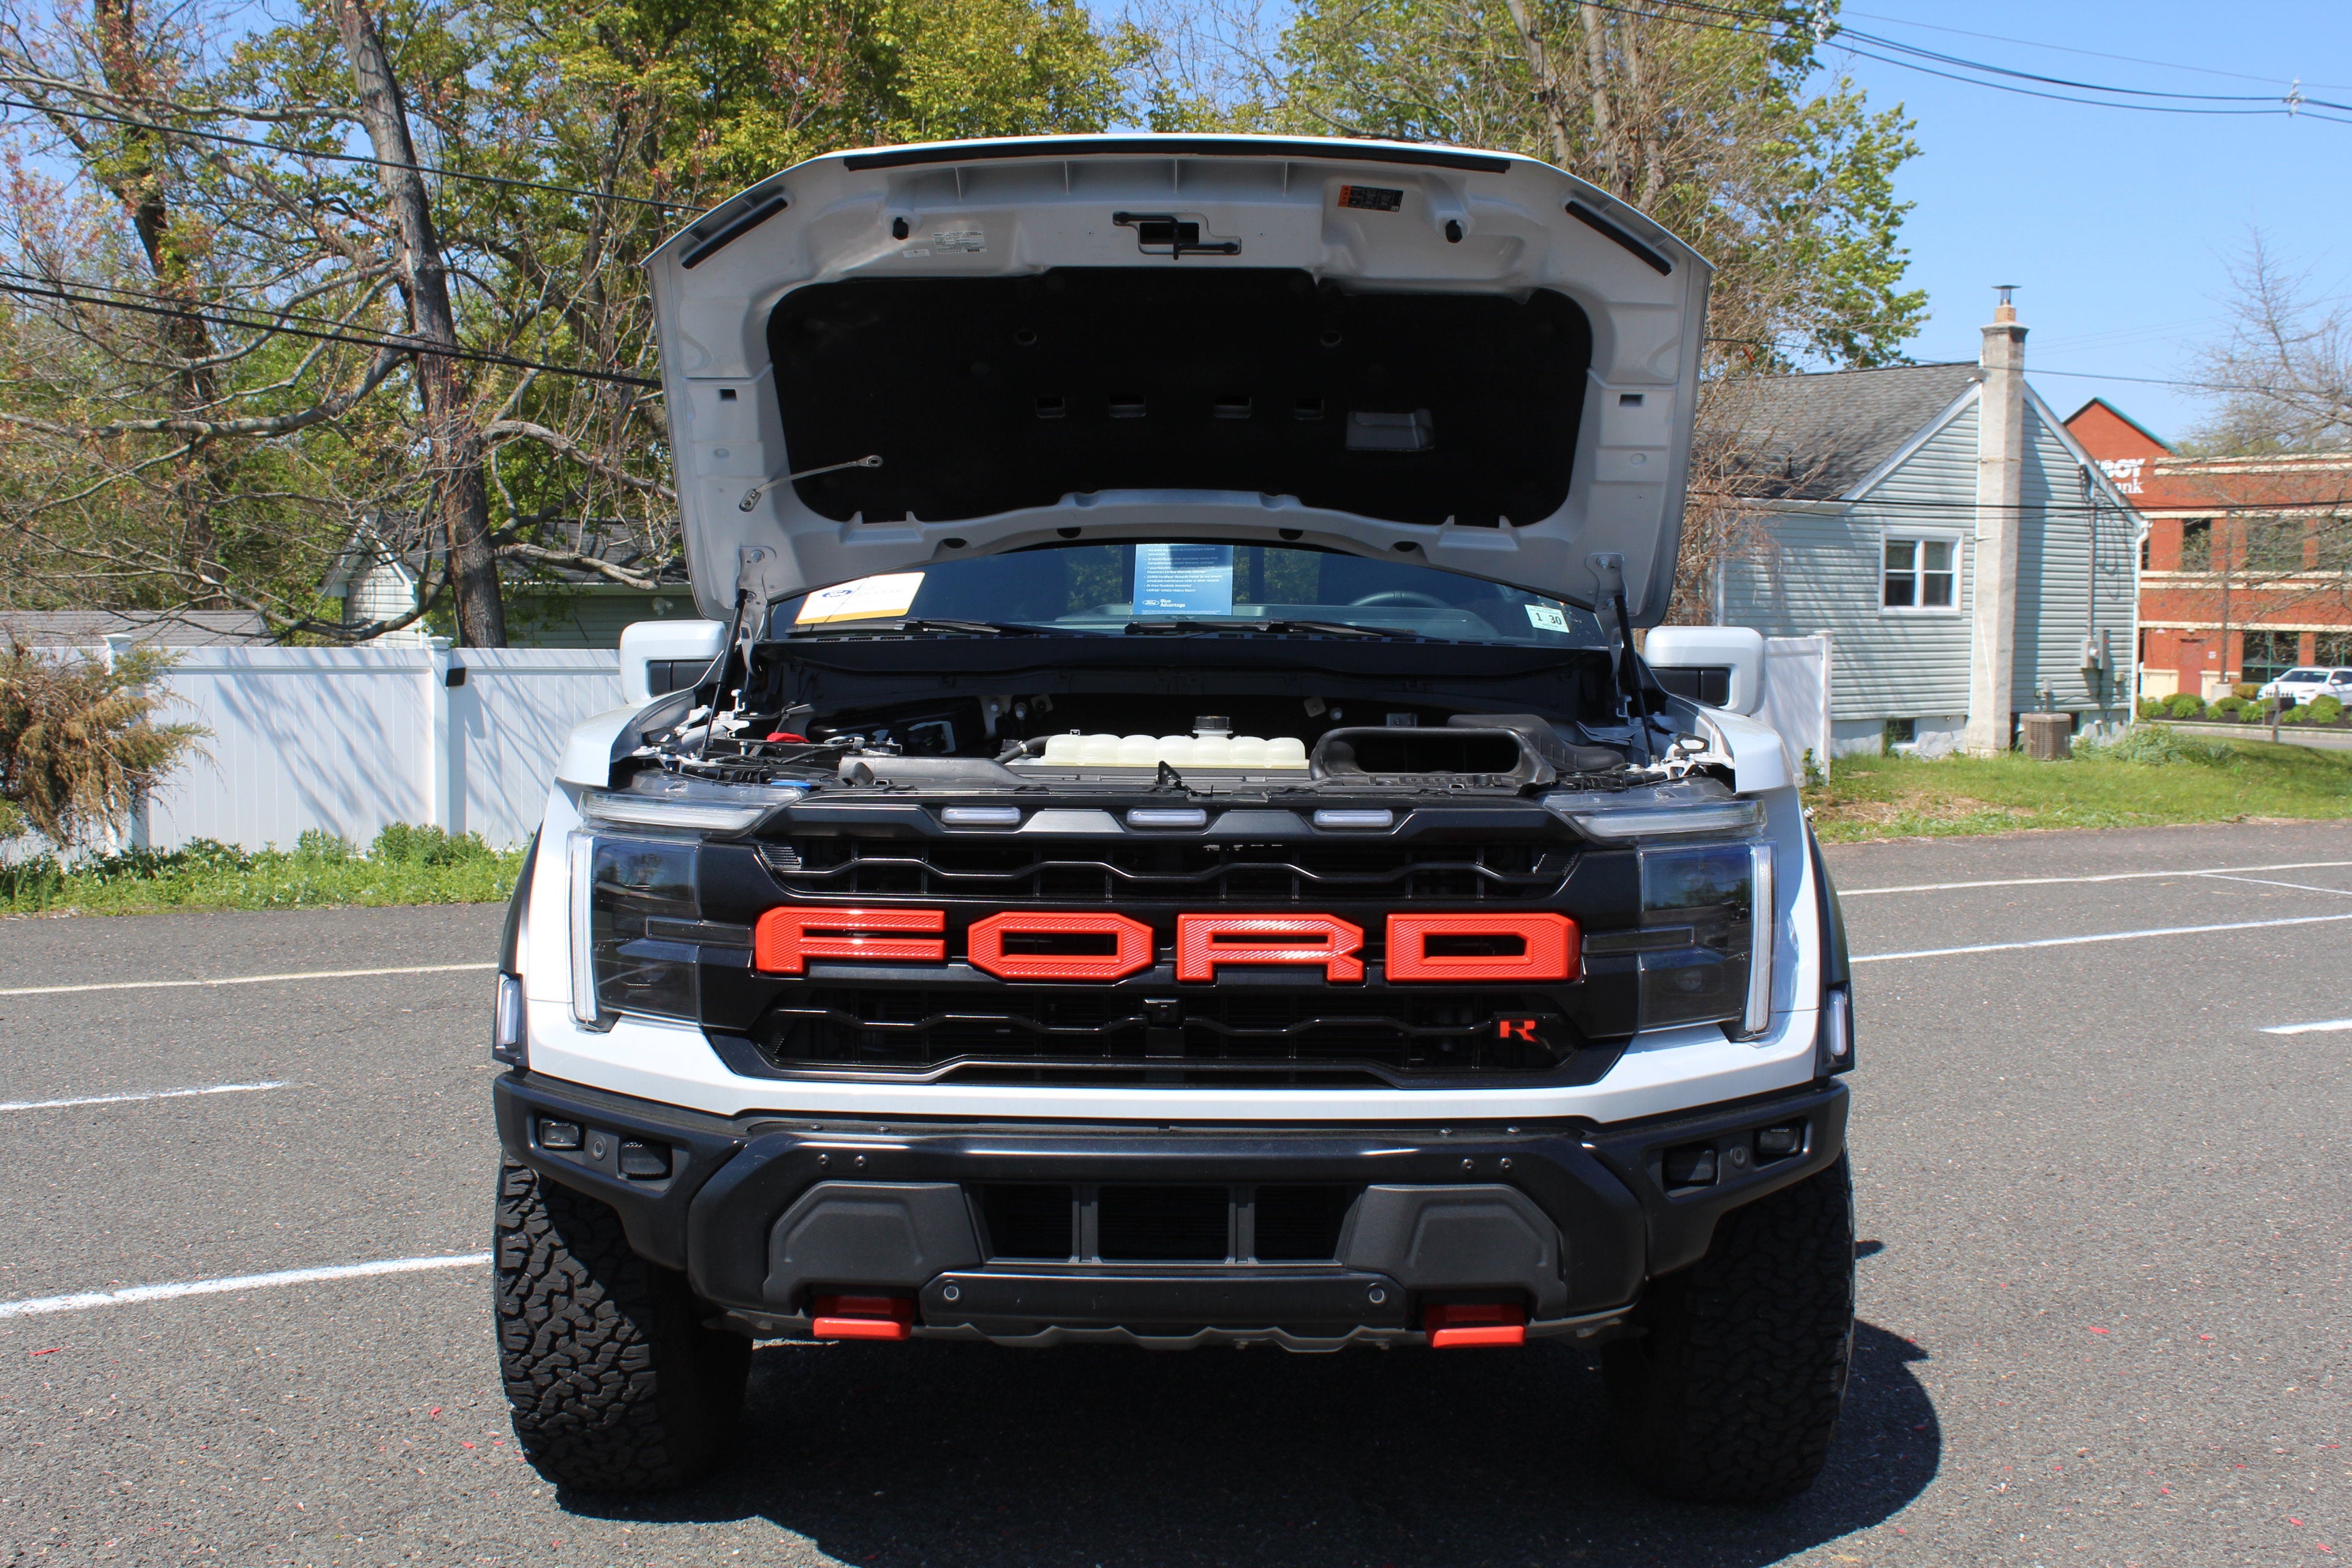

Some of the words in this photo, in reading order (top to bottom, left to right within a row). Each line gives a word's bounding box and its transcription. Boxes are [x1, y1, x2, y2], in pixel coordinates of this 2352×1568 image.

[2095, 459, 2146, 478] BOY
[2114, 478, 2144, 494] ank
[1535, 612, 1544, 622] 1
[1548, 615, 1562, 625] 30
[754, 905, 1581, 983] FORD
[1499, 1020, 1540, 1043] R
